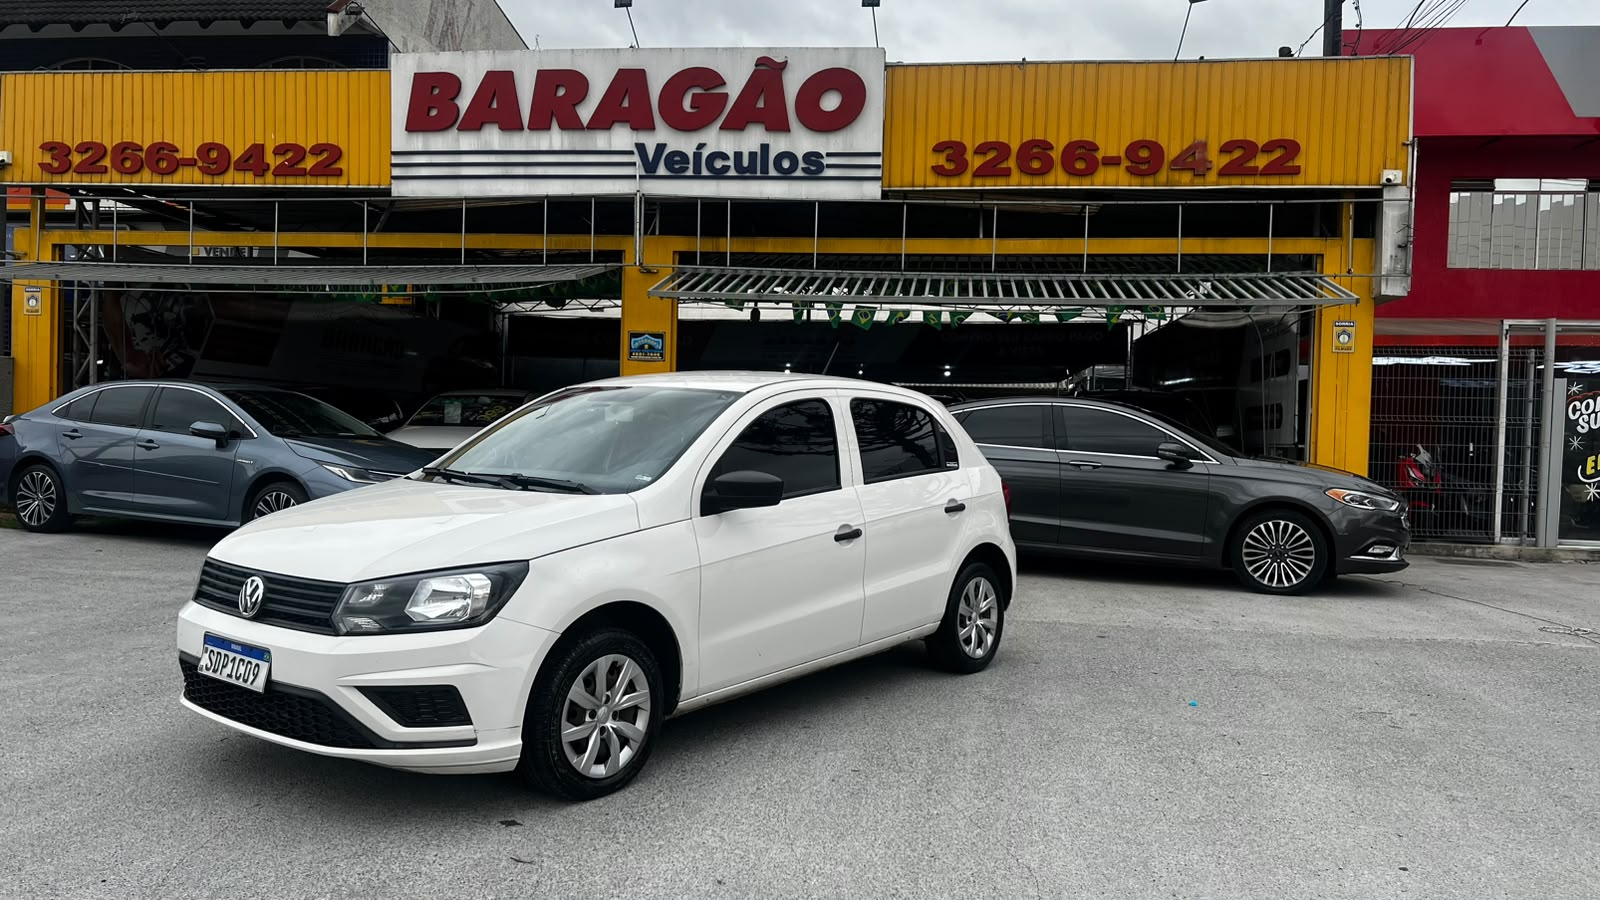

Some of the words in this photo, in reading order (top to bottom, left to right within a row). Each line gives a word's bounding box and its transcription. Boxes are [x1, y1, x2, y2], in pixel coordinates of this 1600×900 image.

[405, 56, 867, 133] BARAGÃO
[38, 141, 343, 177] 3266-9422
[634, 142, 826, 176] Veículos
[931, 139, 1301, 177] 3266-9422
[1586, 454, 1600, 475] E
[205, 649, 260, 686] SDP1C09
